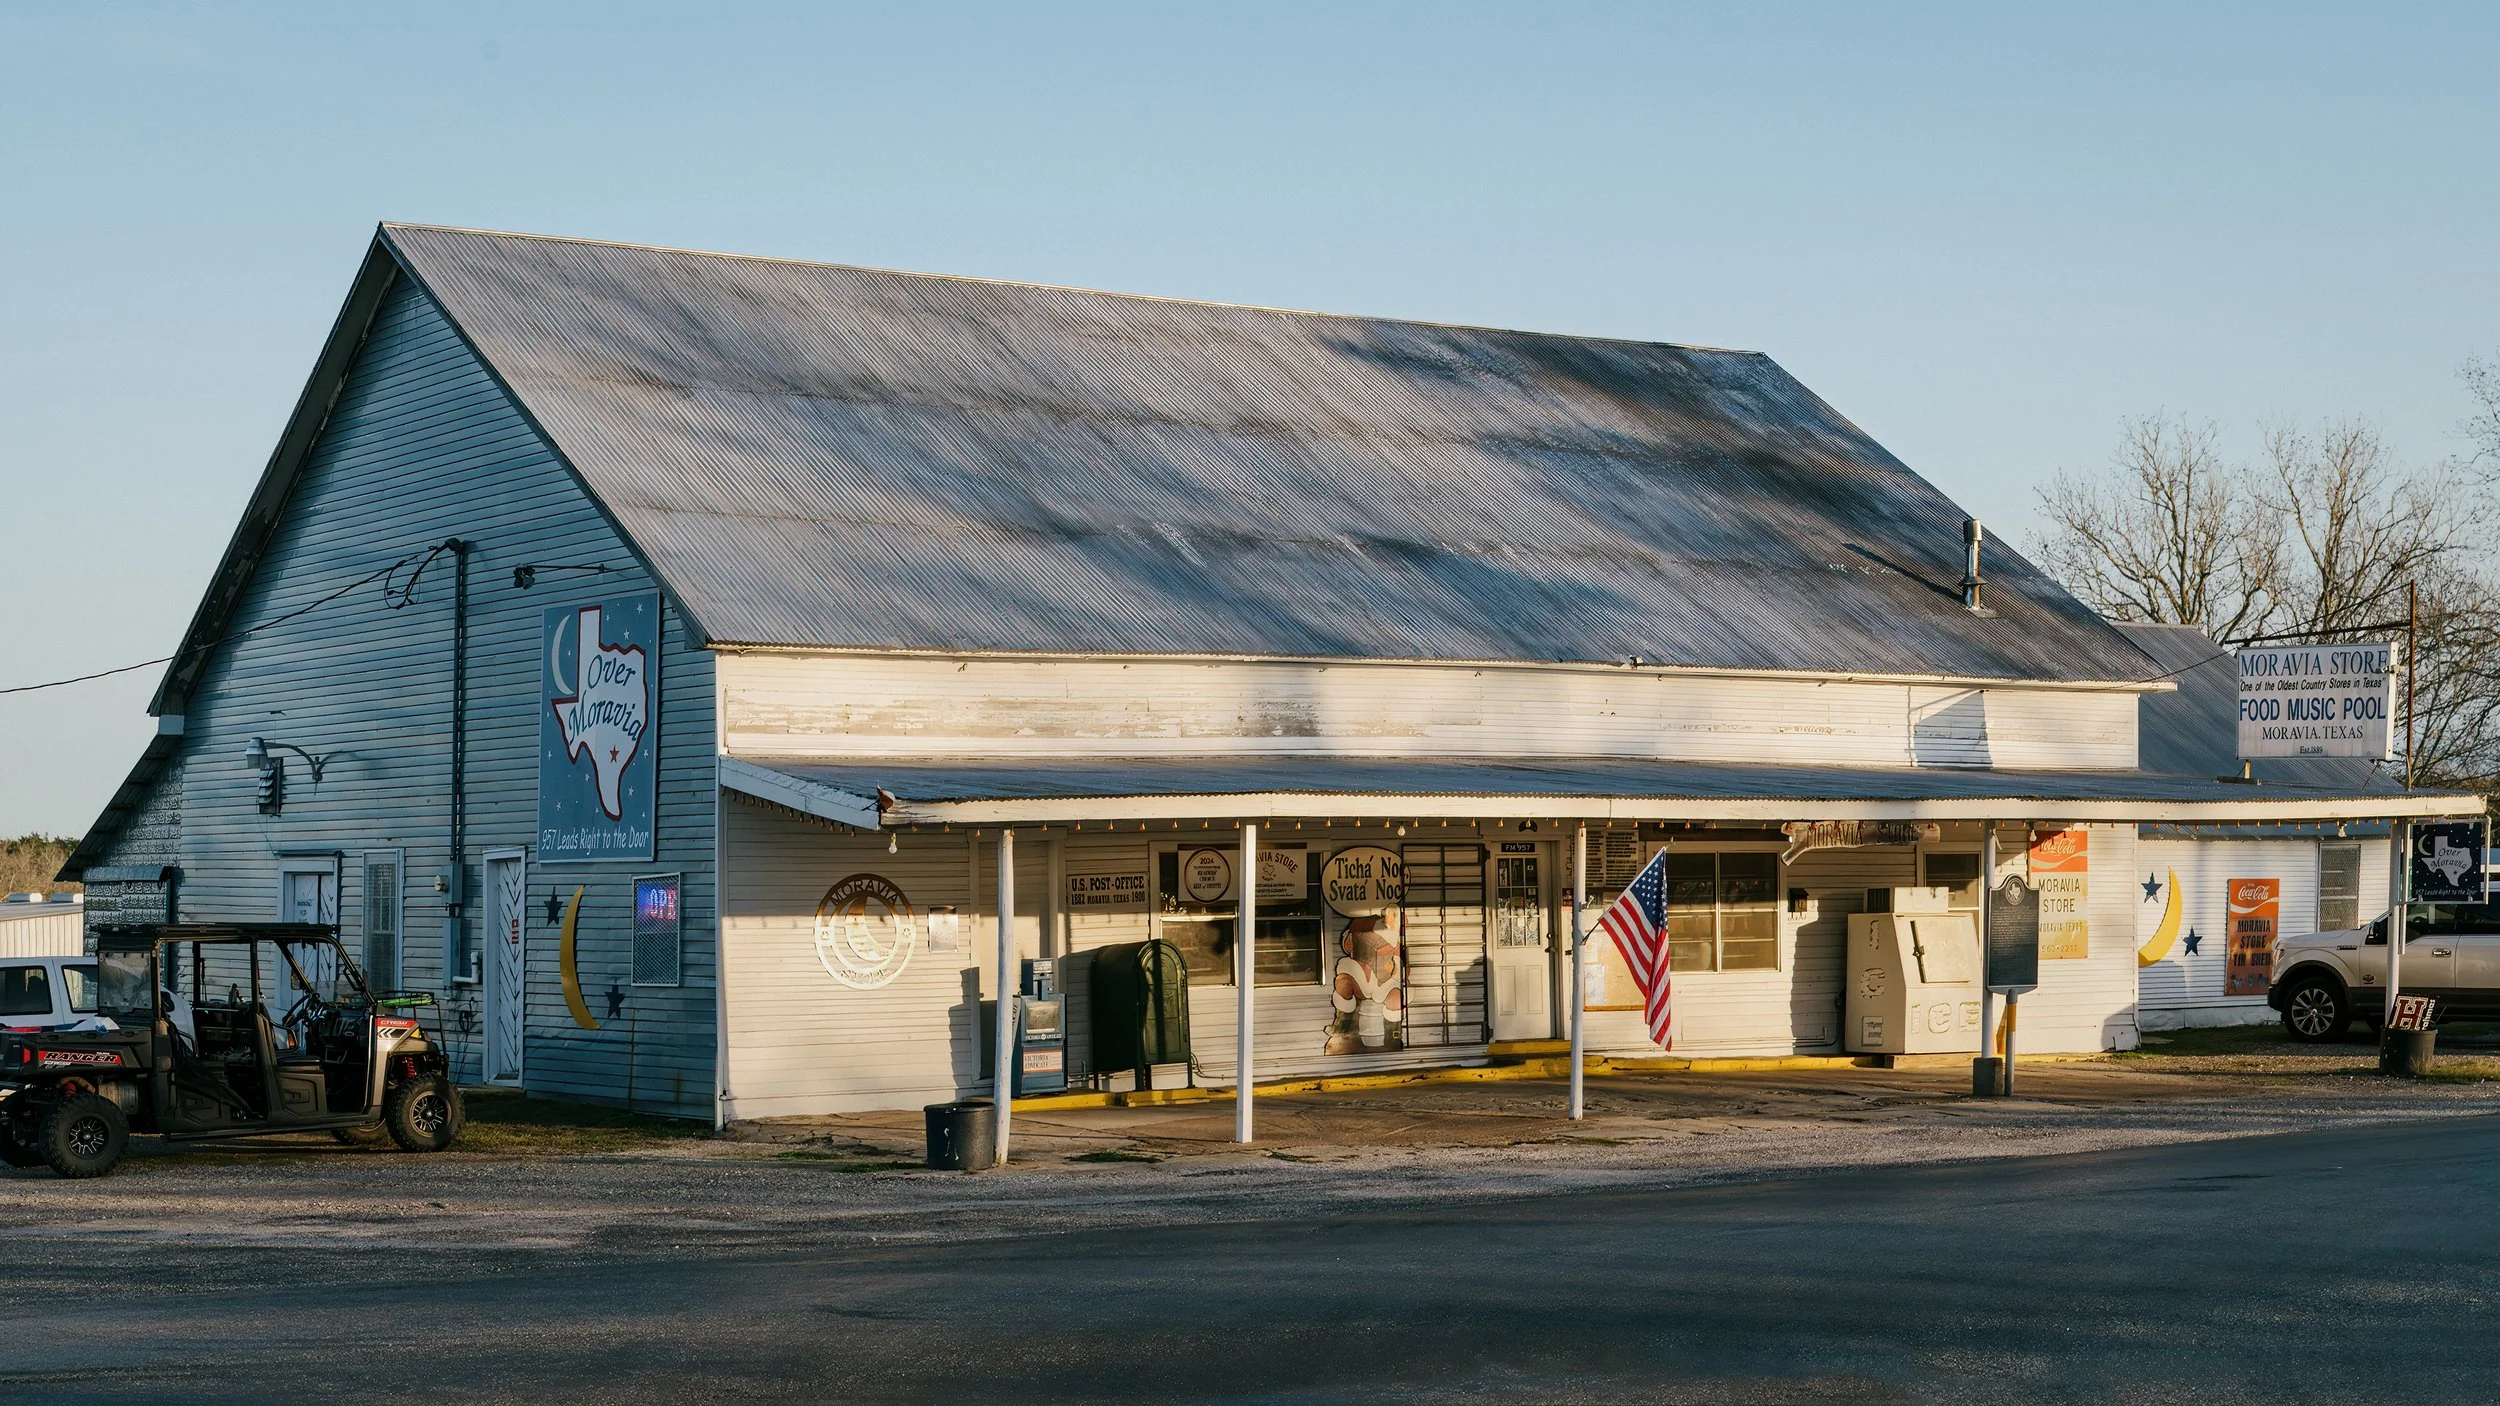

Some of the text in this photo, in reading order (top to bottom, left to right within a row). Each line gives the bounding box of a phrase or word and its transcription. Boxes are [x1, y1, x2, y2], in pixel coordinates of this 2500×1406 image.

[2240, 650, 2388, 677] MORAVIA STORE
[588, 655, 635, 689] Over
[2255, 680, 2262, 692] of
[2265, 681, 2275, 691] the
[2277, 679, 2298, 691] Oldest
[2301, 680, 2327, 692] Country
[2329, 677, 2350, 689] Stores
[2353, 678, 2360, 688] in
[2239, 697, 2386, 721] FOOD MUSIC POOL
[569, 690, 641, 745] Moravia
[2323, 726, 2363, 739] TEXAS
[542, 825, 649, 855] 957 Leads Right to the Door
[1807, 824, 1864, 848] MORAVIA
[2438, 848, 2461, 857] Over
[1200, 857, 1214, 865] 2024
[1274, 852, 1299, 874] STORE
[1335, 855, 1374, 879] Tichá
[2430, 858, 2467, 870] Moravia
[1071, 878, 1088, 891] U.S.
[1329, 879, 1368, 901] Svatá
[2039, 878, 2080, 893] MORAVIA
[830, 879, 900, 906] MORAVIA
[2044, 898, 2075, 913] STORE
[2237, 919, 2271, 933] MORAVIA
[2240, 935, 2266, 949] STORE
[2233, 953, 2246, 967] TIN
[2389, 995, 2429, 1031] H
[44, 1051, 117, 1064] RANGER
[1025, 1054, 1049, 1062] VICTORIA
